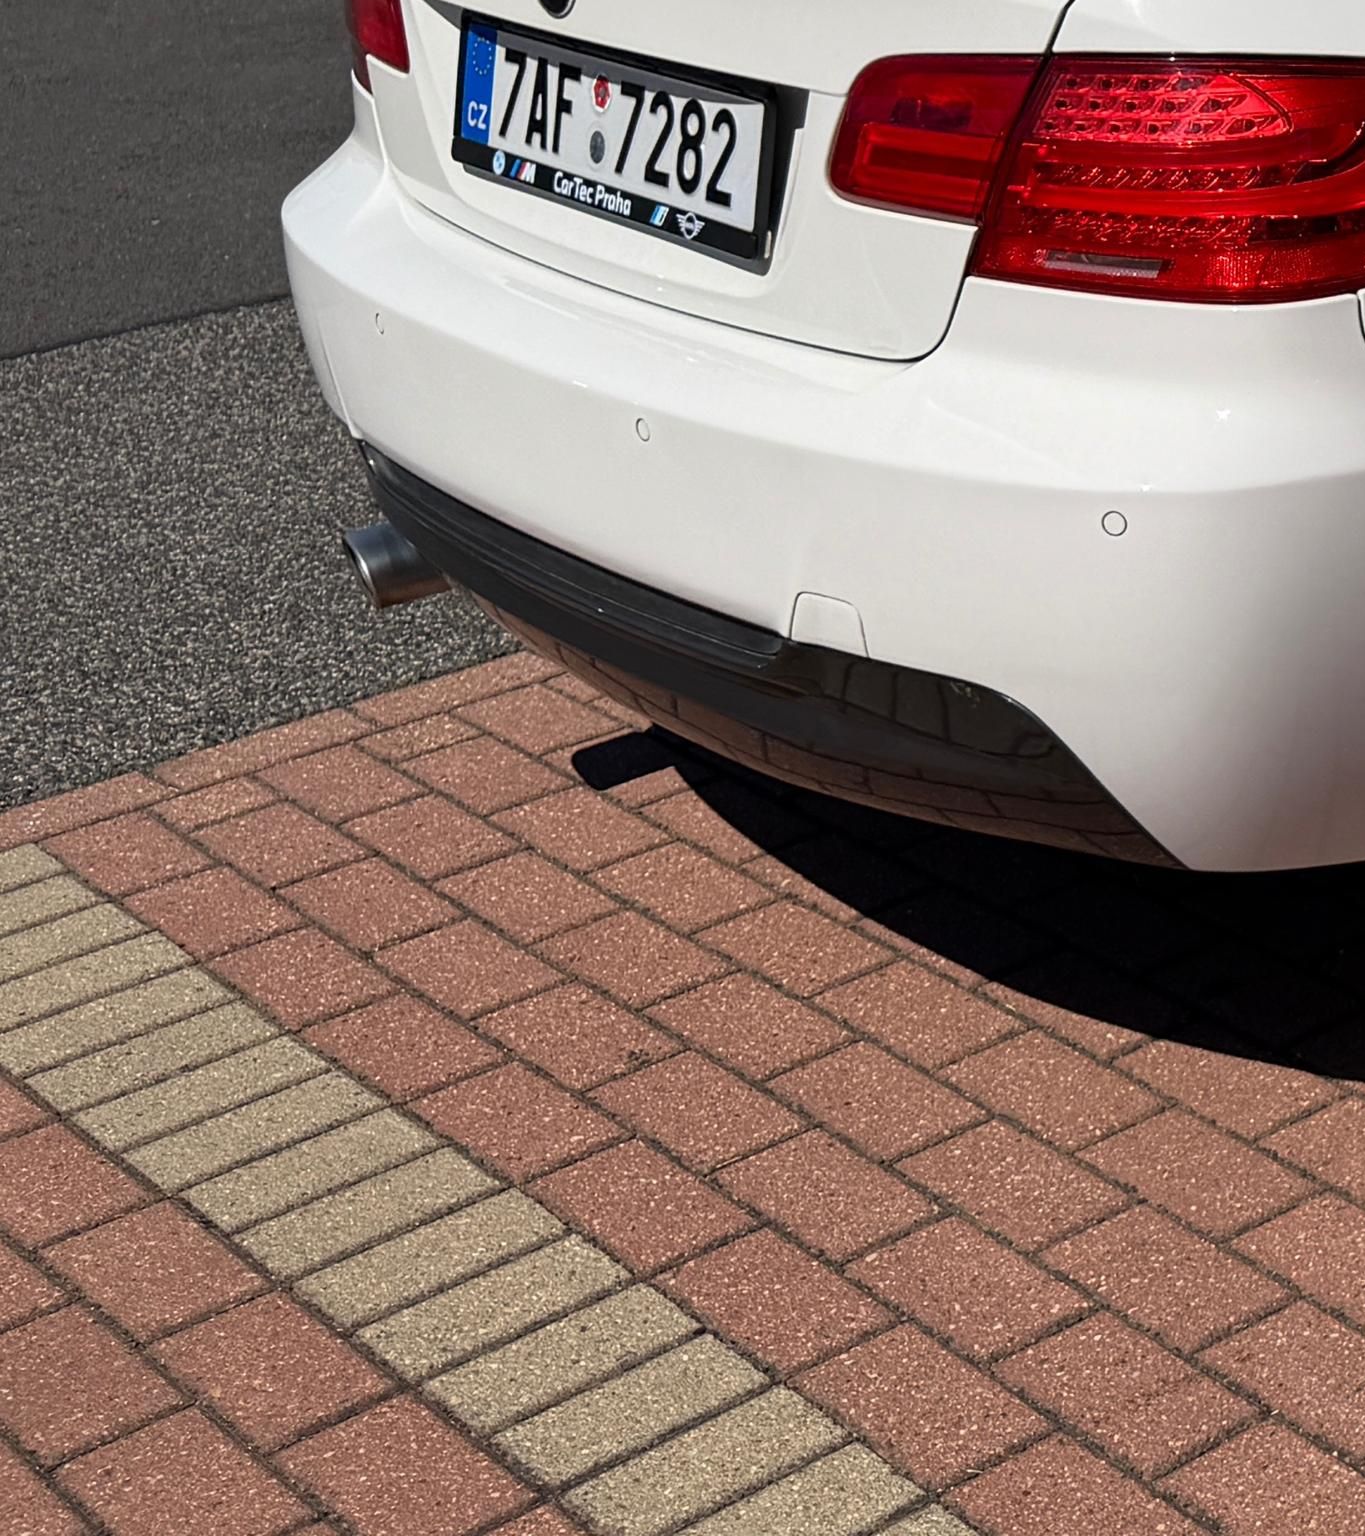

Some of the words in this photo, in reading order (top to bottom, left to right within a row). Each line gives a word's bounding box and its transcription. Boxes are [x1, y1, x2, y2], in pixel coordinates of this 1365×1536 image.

[467, 100, 487, 129] CZ
[499, 47, 582, 154] 7AF
[614, 80, 737, 208] 7282
[553, 171, 594, 204] CarTec
[595, 184, 632, 216] Praha
